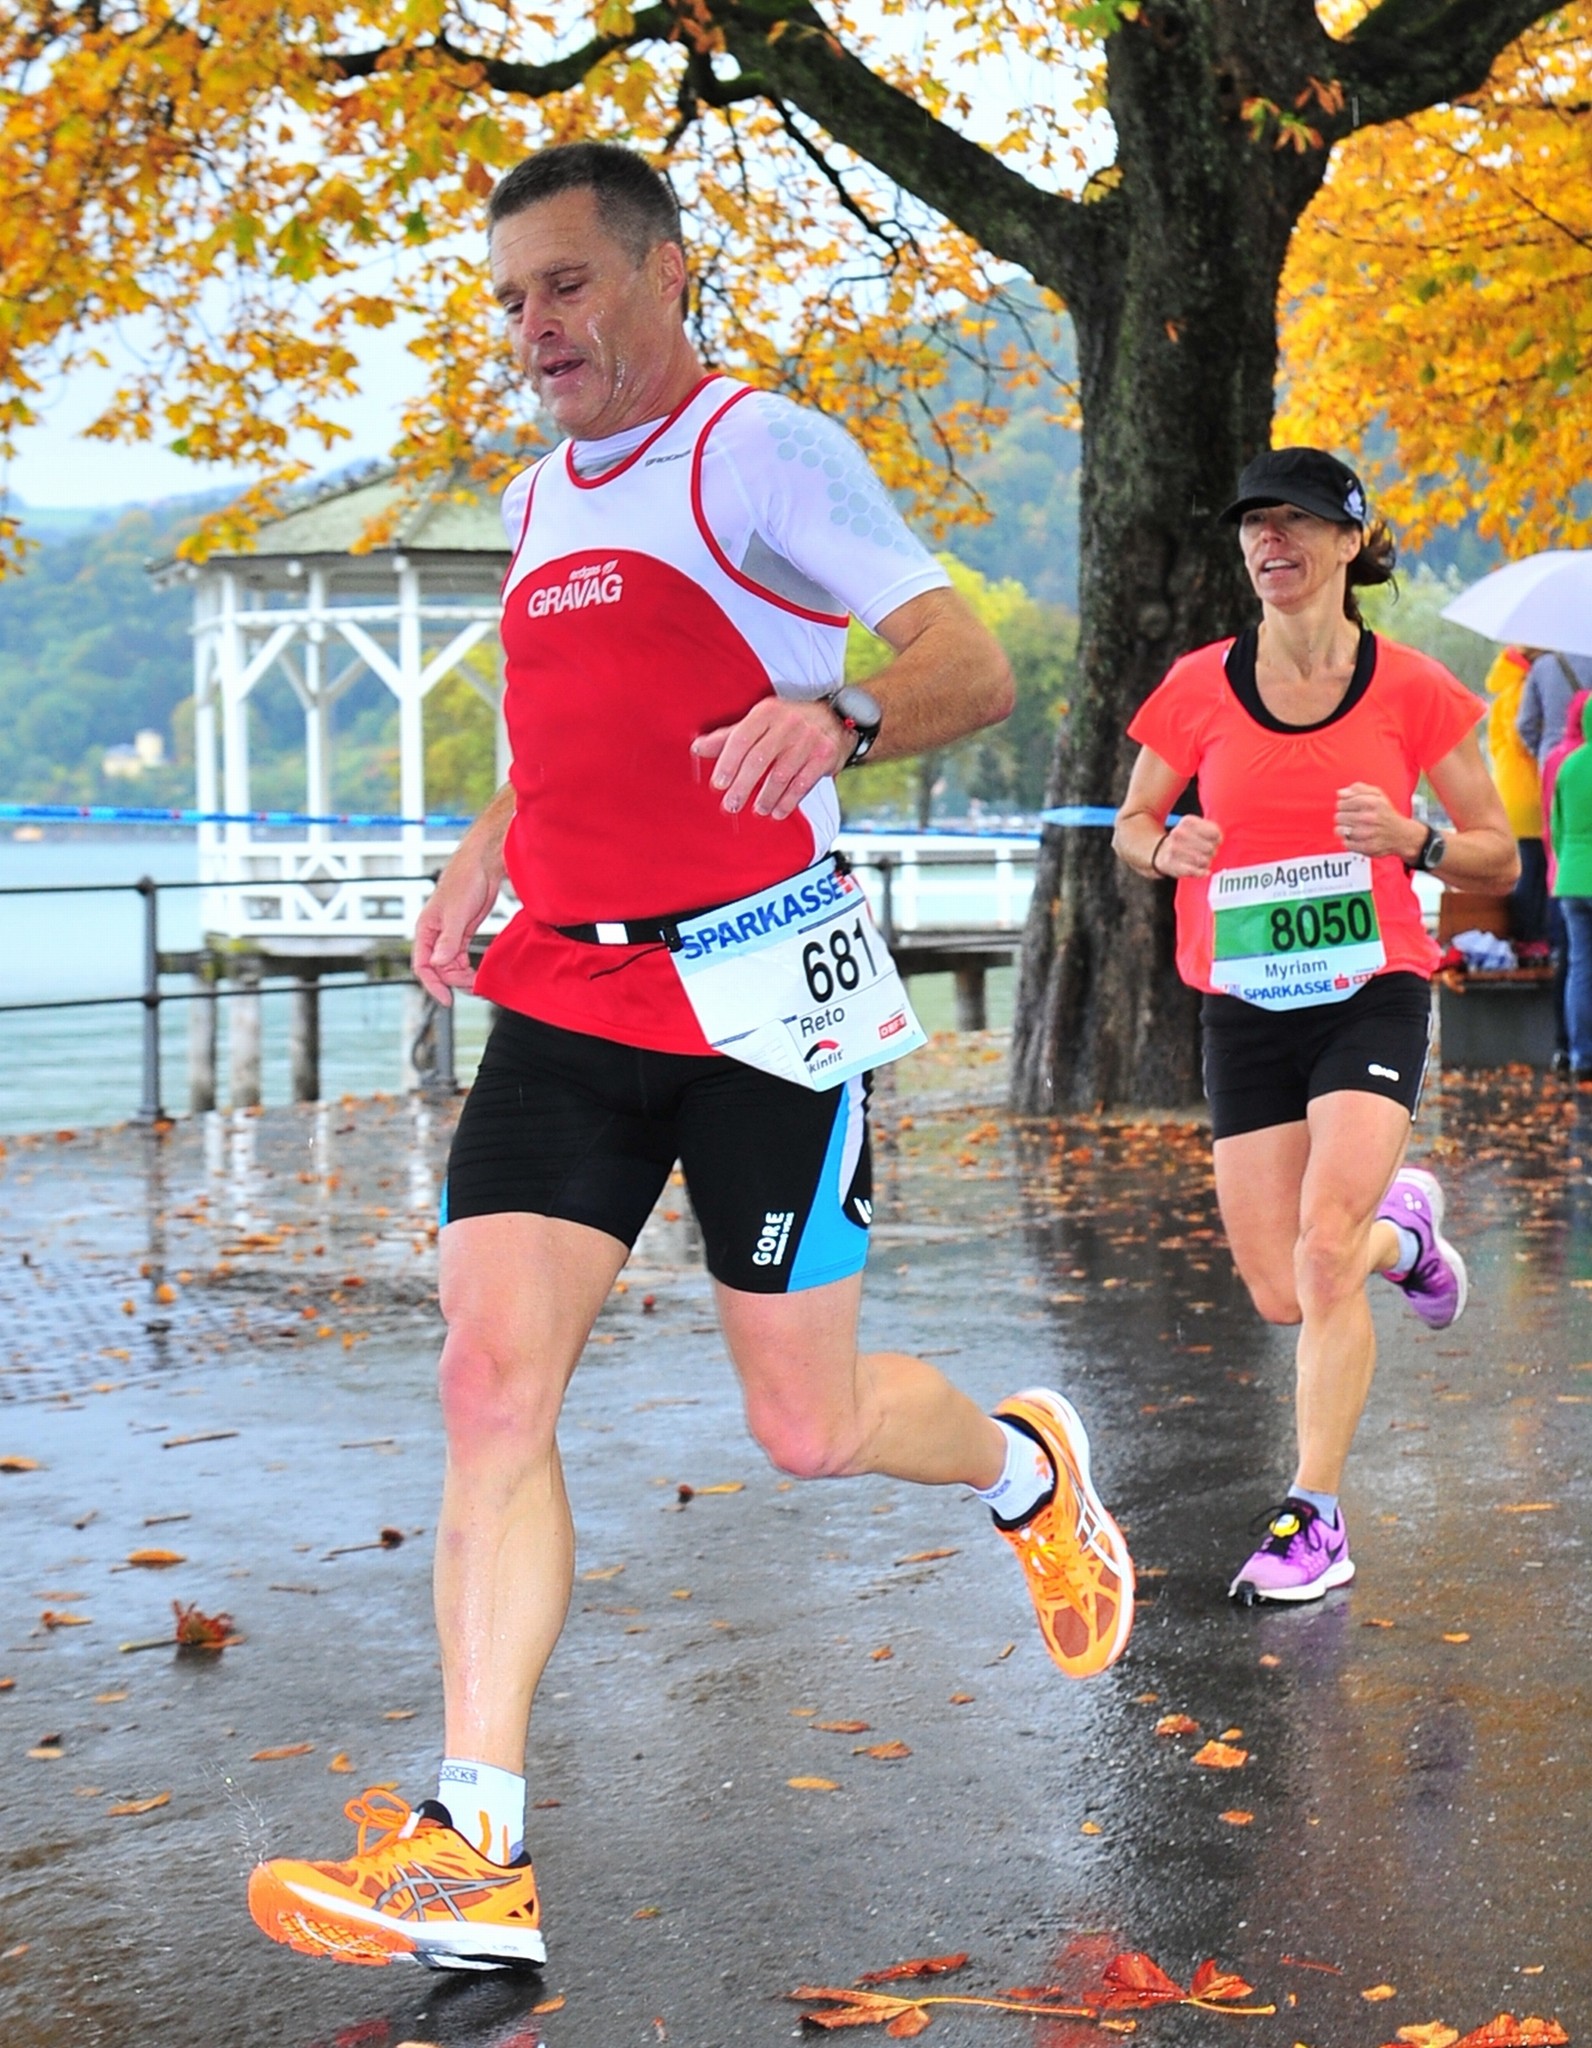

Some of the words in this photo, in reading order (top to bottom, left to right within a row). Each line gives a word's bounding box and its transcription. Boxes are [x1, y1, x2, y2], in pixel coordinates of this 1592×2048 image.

[527, 573, 623, 618] GRAVAG
[681, 872, 843, 960] SPARKASSE
[1271, 897, 1372, 950] 8050
[802, 917, 877, 1003] 681
[1265, 959, 1328, 980] Myriam
[1243, 979, 1333, 1000] SPARKASSE
[800, 1006, 845, 1038] Reto
[808, 1050, 843, 1074] kinfit
[752, 1212, 785, 1266] GORE
